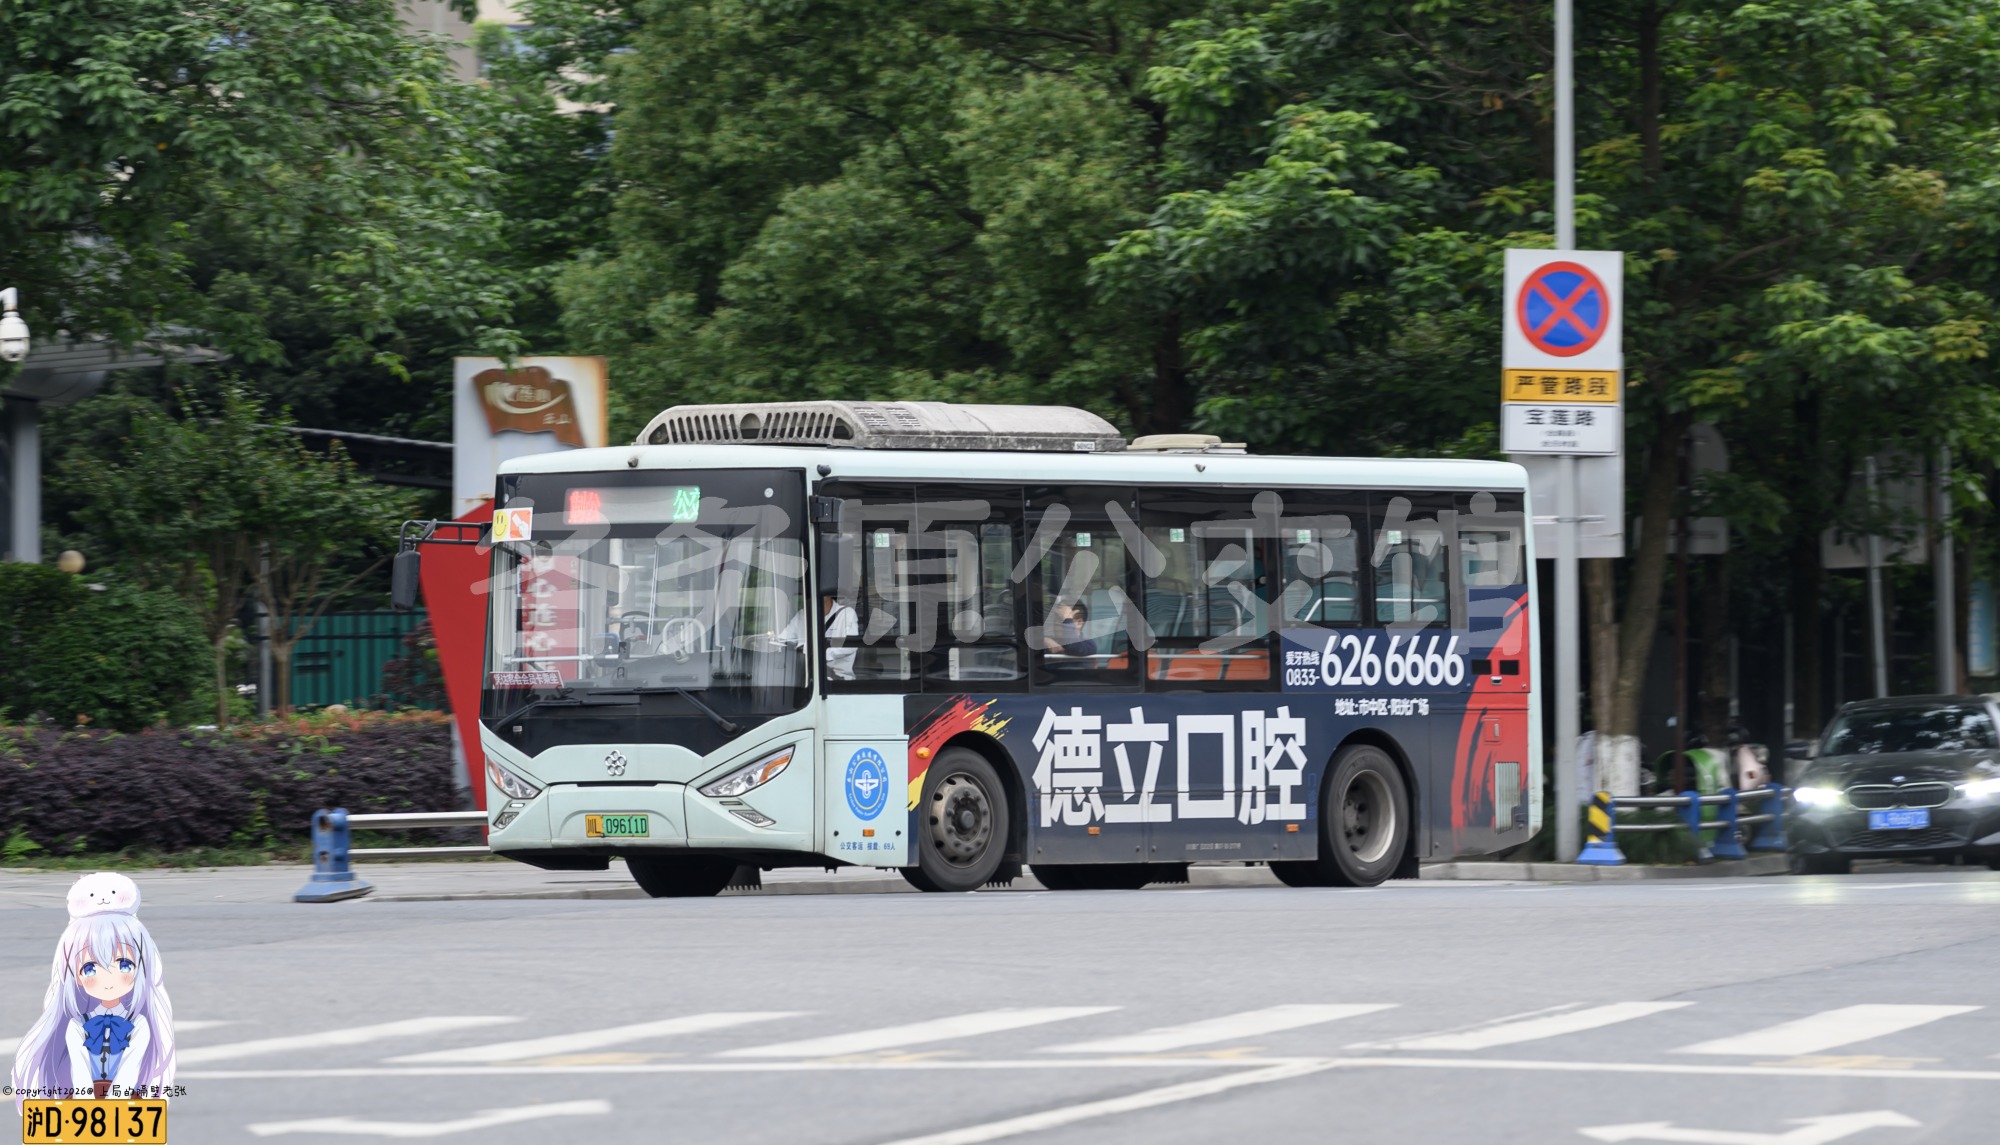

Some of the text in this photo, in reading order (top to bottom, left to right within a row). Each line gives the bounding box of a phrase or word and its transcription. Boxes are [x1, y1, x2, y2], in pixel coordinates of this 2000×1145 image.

[1513, 376, 1610, 396] 严管路段
[1285, 651, 1320, 666] 爱牙热线
[1286, 668, 1320, 686] 0833-
[1031, 705, 1308, 827] 德立口腔
